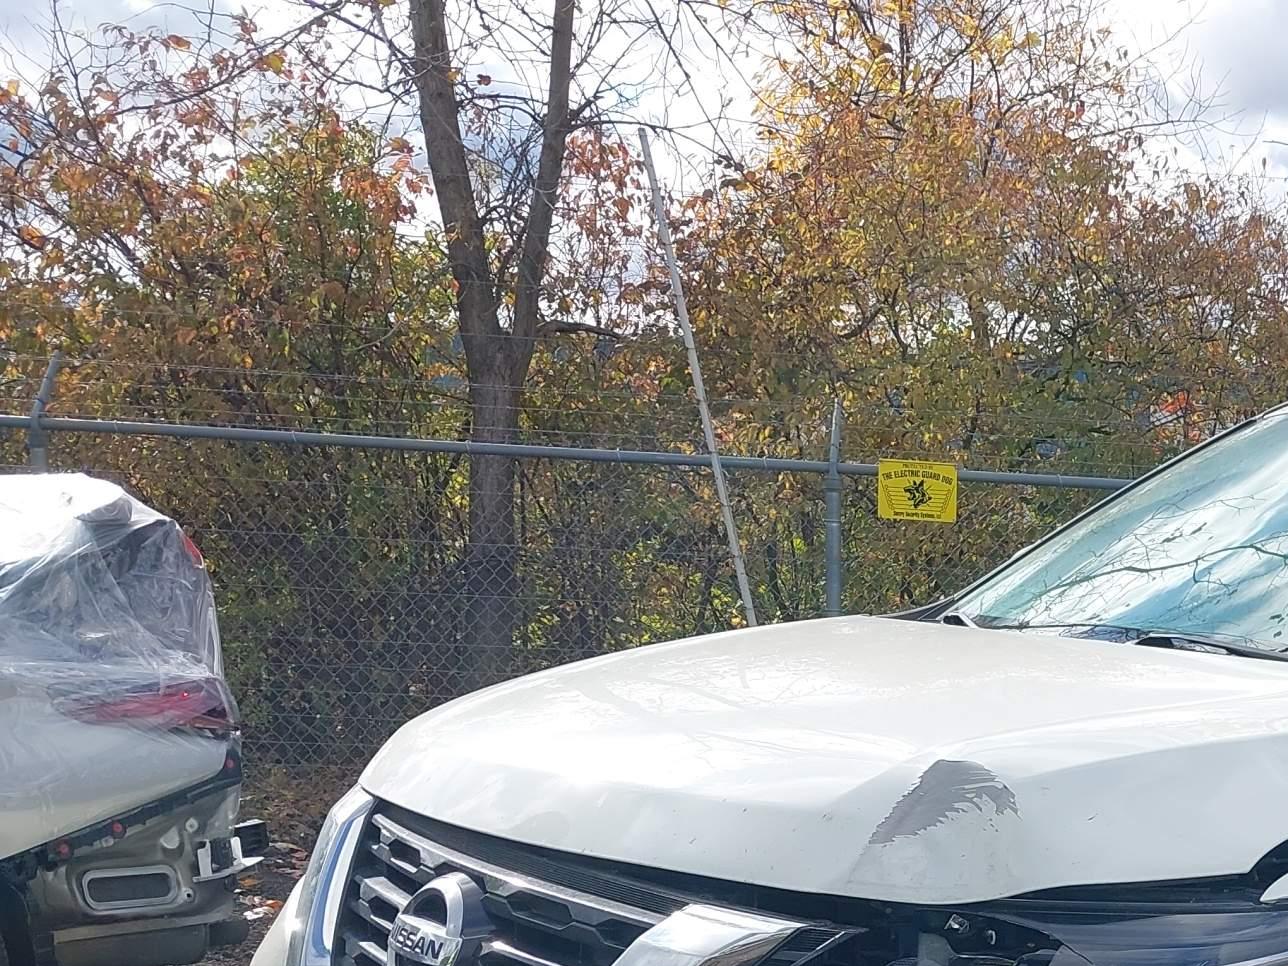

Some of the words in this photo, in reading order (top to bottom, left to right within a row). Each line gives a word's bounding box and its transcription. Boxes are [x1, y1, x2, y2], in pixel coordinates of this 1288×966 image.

[882, 471, 893, 480] THE
[894, 469, 921, 478] ELECTRIC
[921, 470, 940, 481] GUARD
[941, 475, 954, 486] DOG
